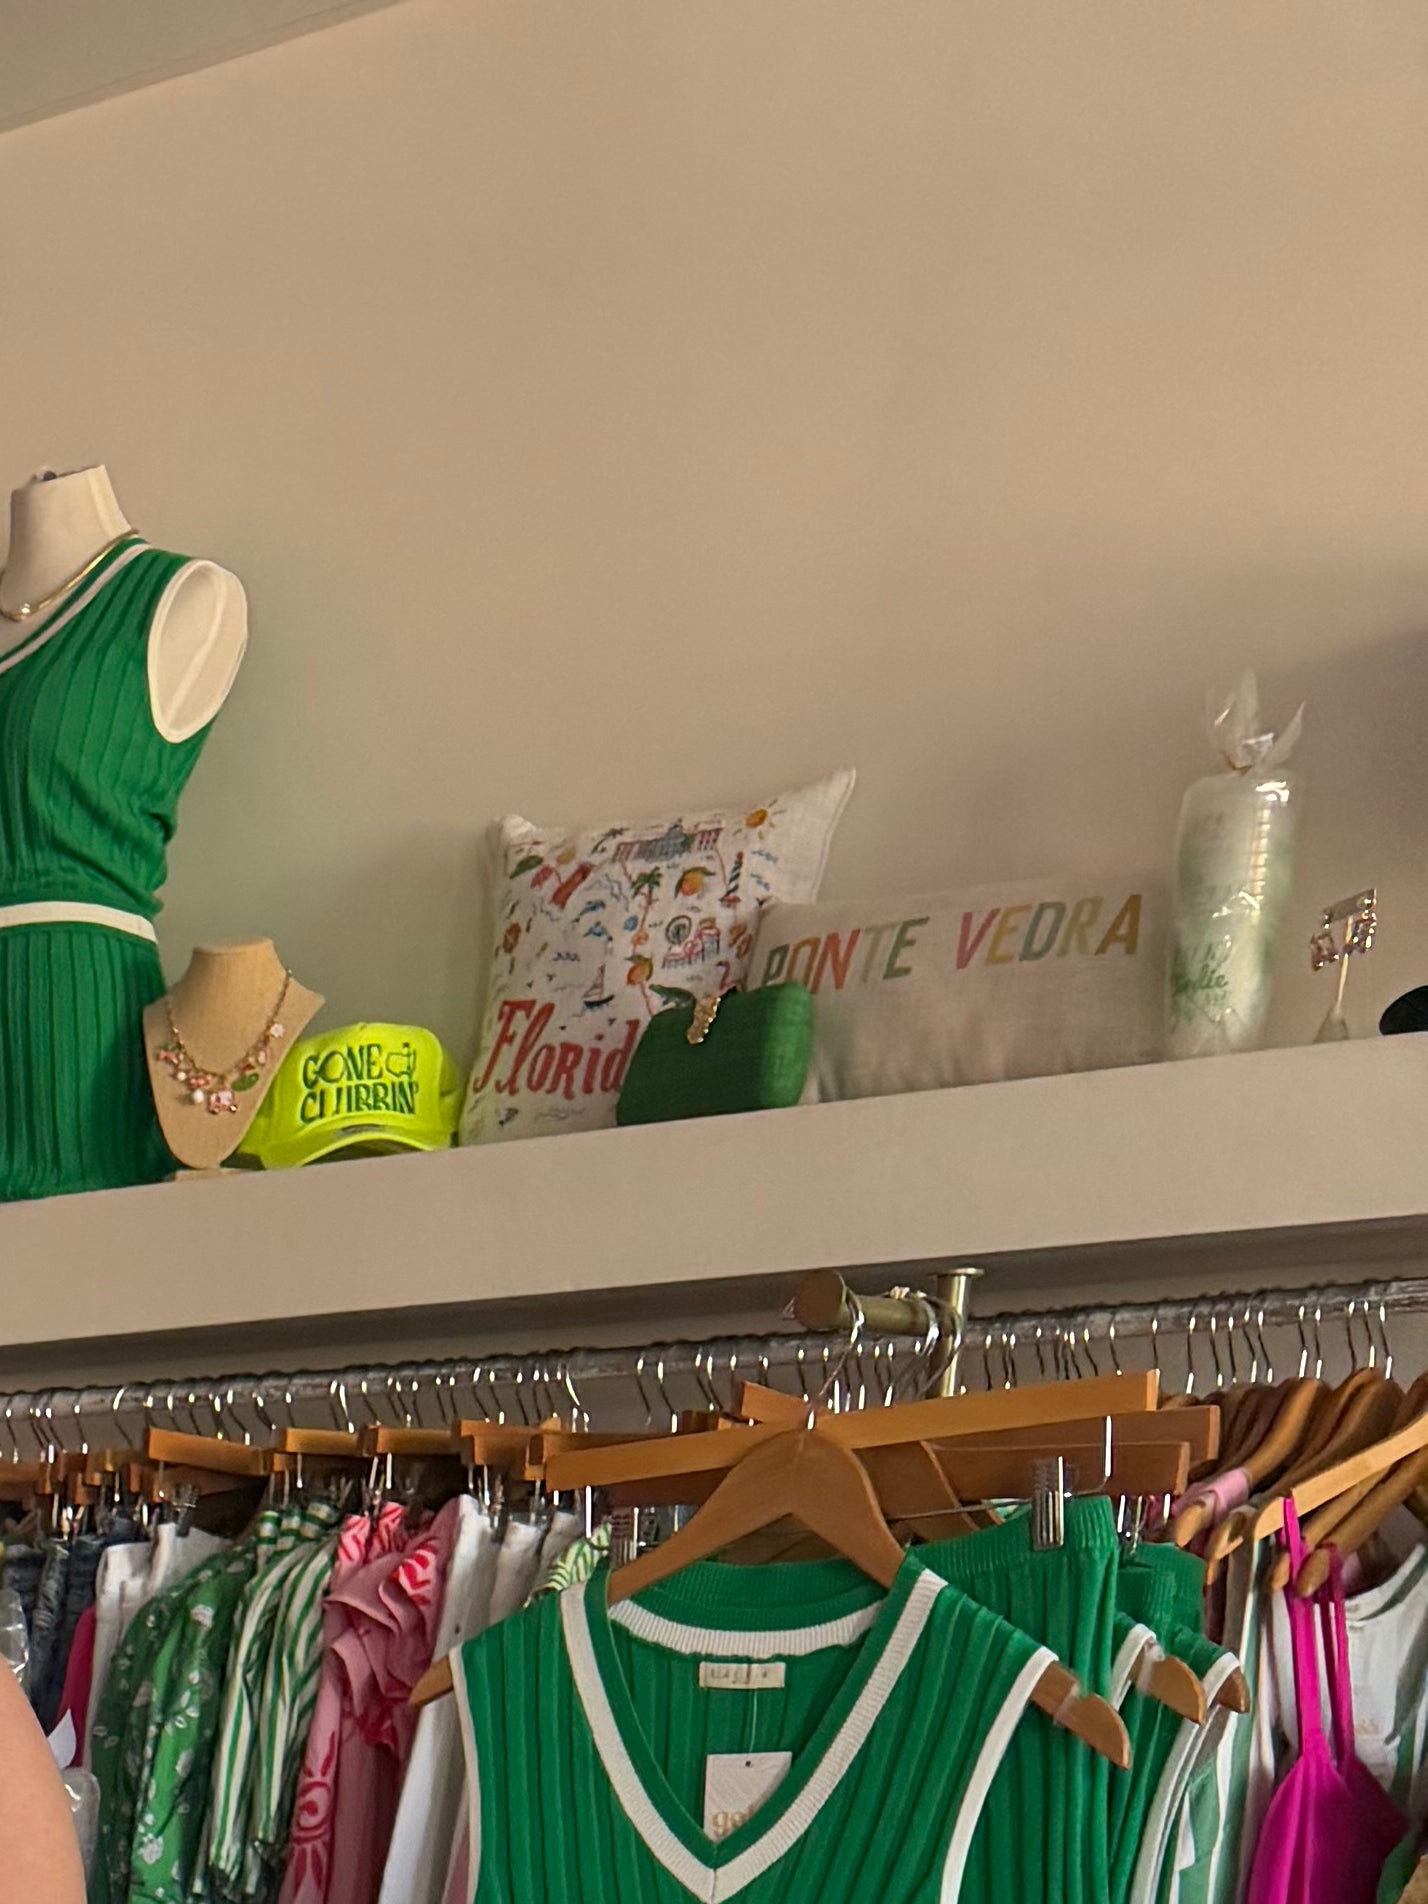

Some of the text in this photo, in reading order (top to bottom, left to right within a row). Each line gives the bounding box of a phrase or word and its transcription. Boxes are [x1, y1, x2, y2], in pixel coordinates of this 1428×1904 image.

[762, 916, 931, 995] PONTE
[956, 893, 1143, 970] VEDRA
[302, 1043, 384, 1090] GONE
[472, 998, 641, 1101] Florid
